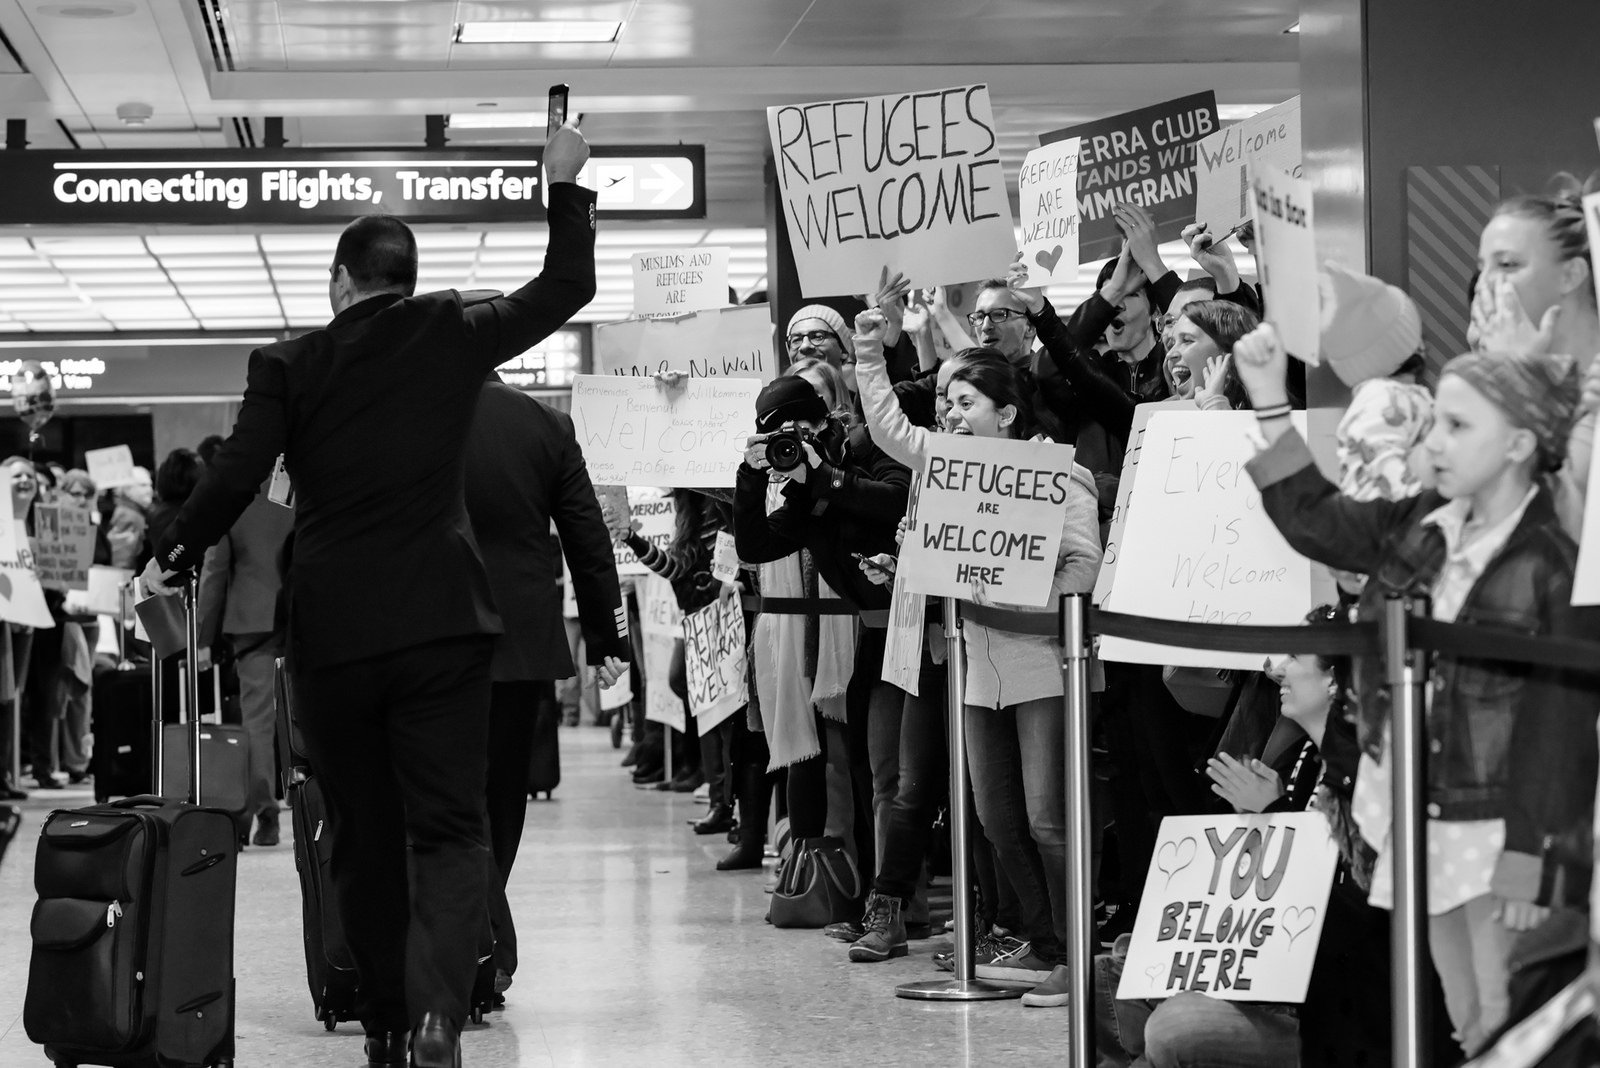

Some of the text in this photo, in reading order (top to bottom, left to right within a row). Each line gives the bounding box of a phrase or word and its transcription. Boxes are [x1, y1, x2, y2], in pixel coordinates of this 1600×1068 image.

[777, 85, 995, 189] REFUGEES
[1078, 108, 1213, 166] ERRA CLUB
[1200, 124, 1286, 173] Welcome
[1021, 154, 1078, 188] REFUGEES
[1077, 141, 1198, 191] TANDS WIT
[53, 170, 537, 208] Connecting Flights, Transfer
[789, 160, 1001, 249] WELCOME
[1037, 188, 1062, 217] ARE
[1076, 165, 1198, 223] MMIGRAN
[1024, 214, 1077, 245] WELCOME
[640, 253, 712, 272] MUSLIMS AND
[656, 270, 703, 287] REFUGEES
[665, 290, 686, 304] ARE
[689, 358, 716, 378] No
[722, 350, 762, 375] Wall
[687, 385, 751, 400] Willkommen
[580, 404, 749, 454] Welcome
[927, 456, 1068, 505] REFUGEES
[629, 502, 673, 516] MERICA
[977, 502, 1000, 515] ARE
[923, 523, 1047, 562] WELCOME
[1212, 514, 1241, 544] is
[956, 564, 1005, 585] HERE
[1172, 552, 1287, 590] Welcome
[1204, 825, 1296, 901] YOU
[1157, 900, 1275, 947] BELONG
[1166, 949, 1259, 992] HERE
